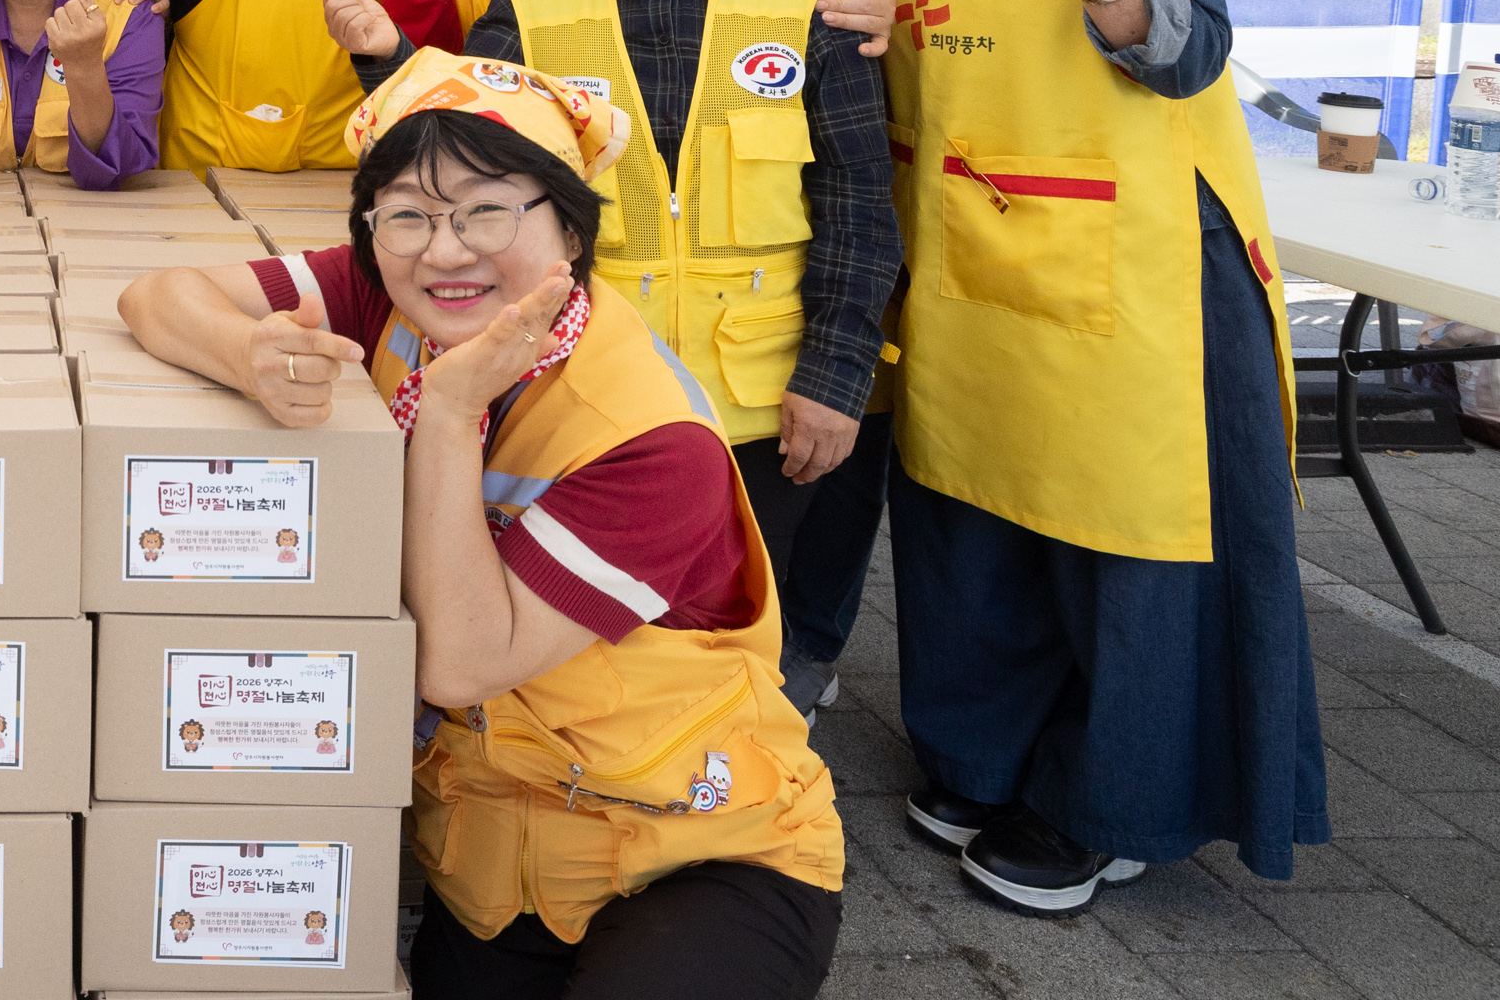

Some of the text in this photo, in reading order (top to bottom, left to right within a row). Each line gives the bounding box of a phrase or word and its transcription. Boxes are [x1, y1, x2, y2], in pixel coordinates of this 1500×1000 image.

[930, 33, 995, 55] 희망풍차
[737, 47, 763, 64] KOREAN
[781, 49, 800, 66] CROSS
[758, 86, 787, 96] 봉사원
[224, 486, 253, 494] 양주시
[196, 497, 285, 511] 명절나눔축제
[264, 678, 292, 687] 양주시
[236, 690, 324, 703] 명절나눔축제
[228, 868, 282, 877] 2026 양주시
[227, 880, 314, 894] 명절나눔축제
